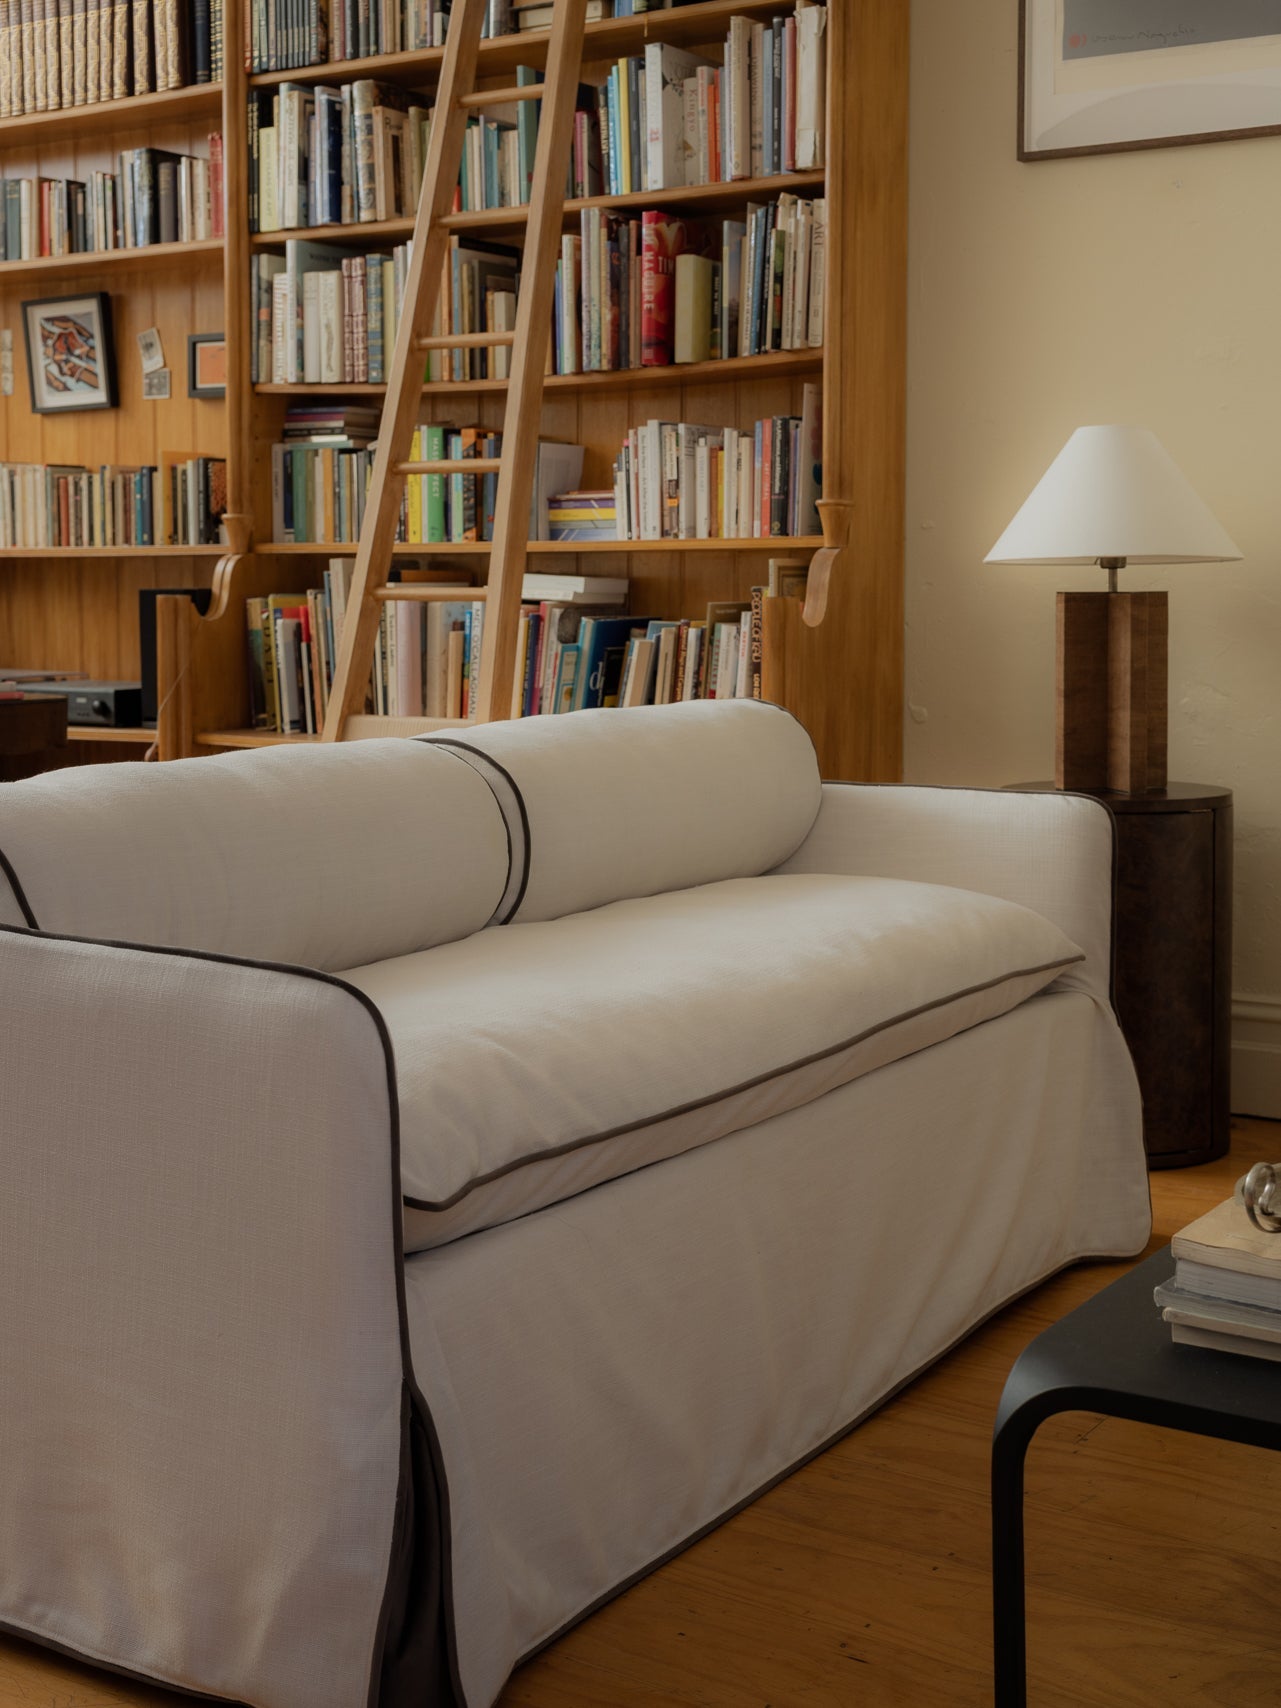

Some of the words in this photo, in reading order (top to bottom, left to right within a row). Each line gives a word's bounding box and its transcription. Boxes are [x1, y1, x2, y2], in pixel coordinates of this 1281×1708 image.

[687, 88, 698, 132] Kingyo
[643, 222, 654, 244] TIM
[813, 221, 825, 246] ART
[643, 251, 654, 311] MAGUIRE
[752, 591, 761, 628] PEOPLE
[469, 634, 481, 715] O'CALLAGHAN
